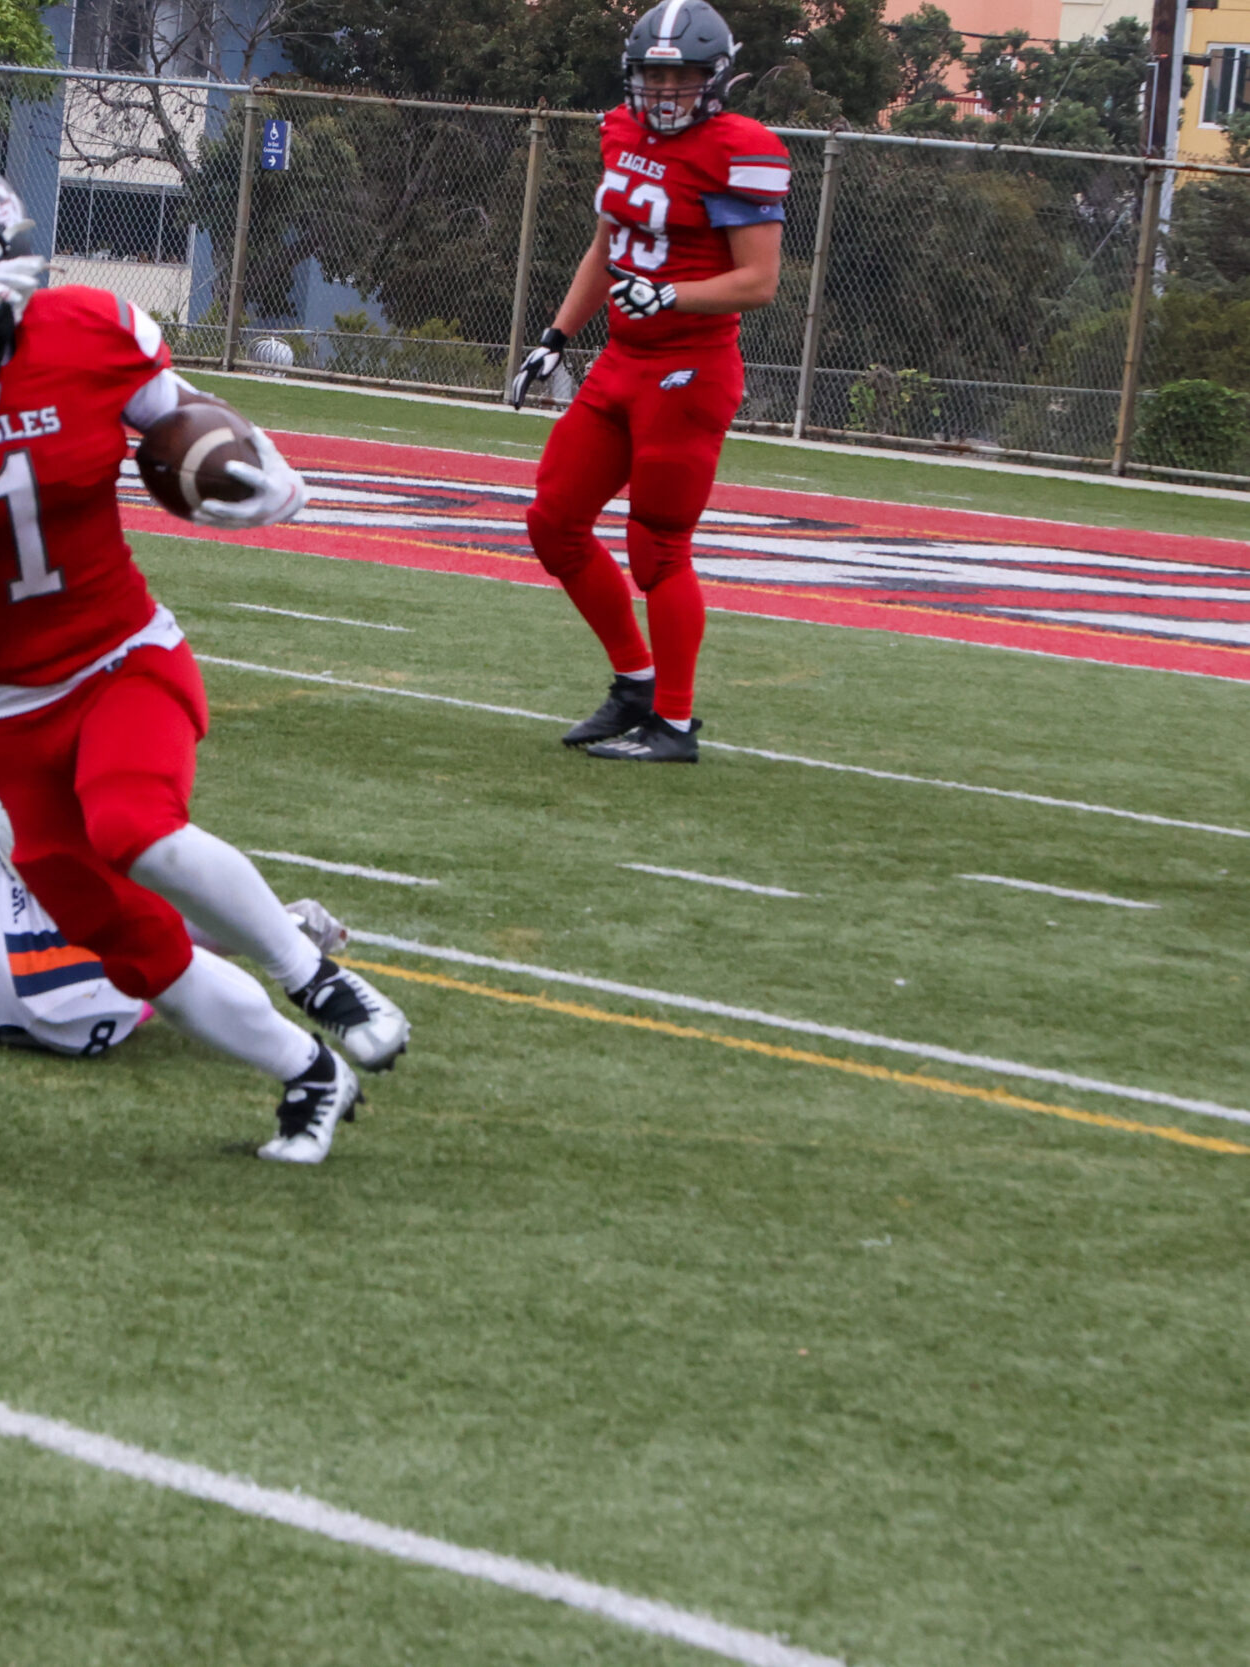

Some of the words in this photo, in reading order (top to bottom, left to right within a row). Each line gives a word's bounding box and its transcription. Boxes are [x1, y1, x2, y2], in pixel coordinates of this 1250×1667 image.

[617, 151, 667, 180] EAGLES
[595, 170, 671, 271] 53
[82, 1020, 117, 1056] 8
